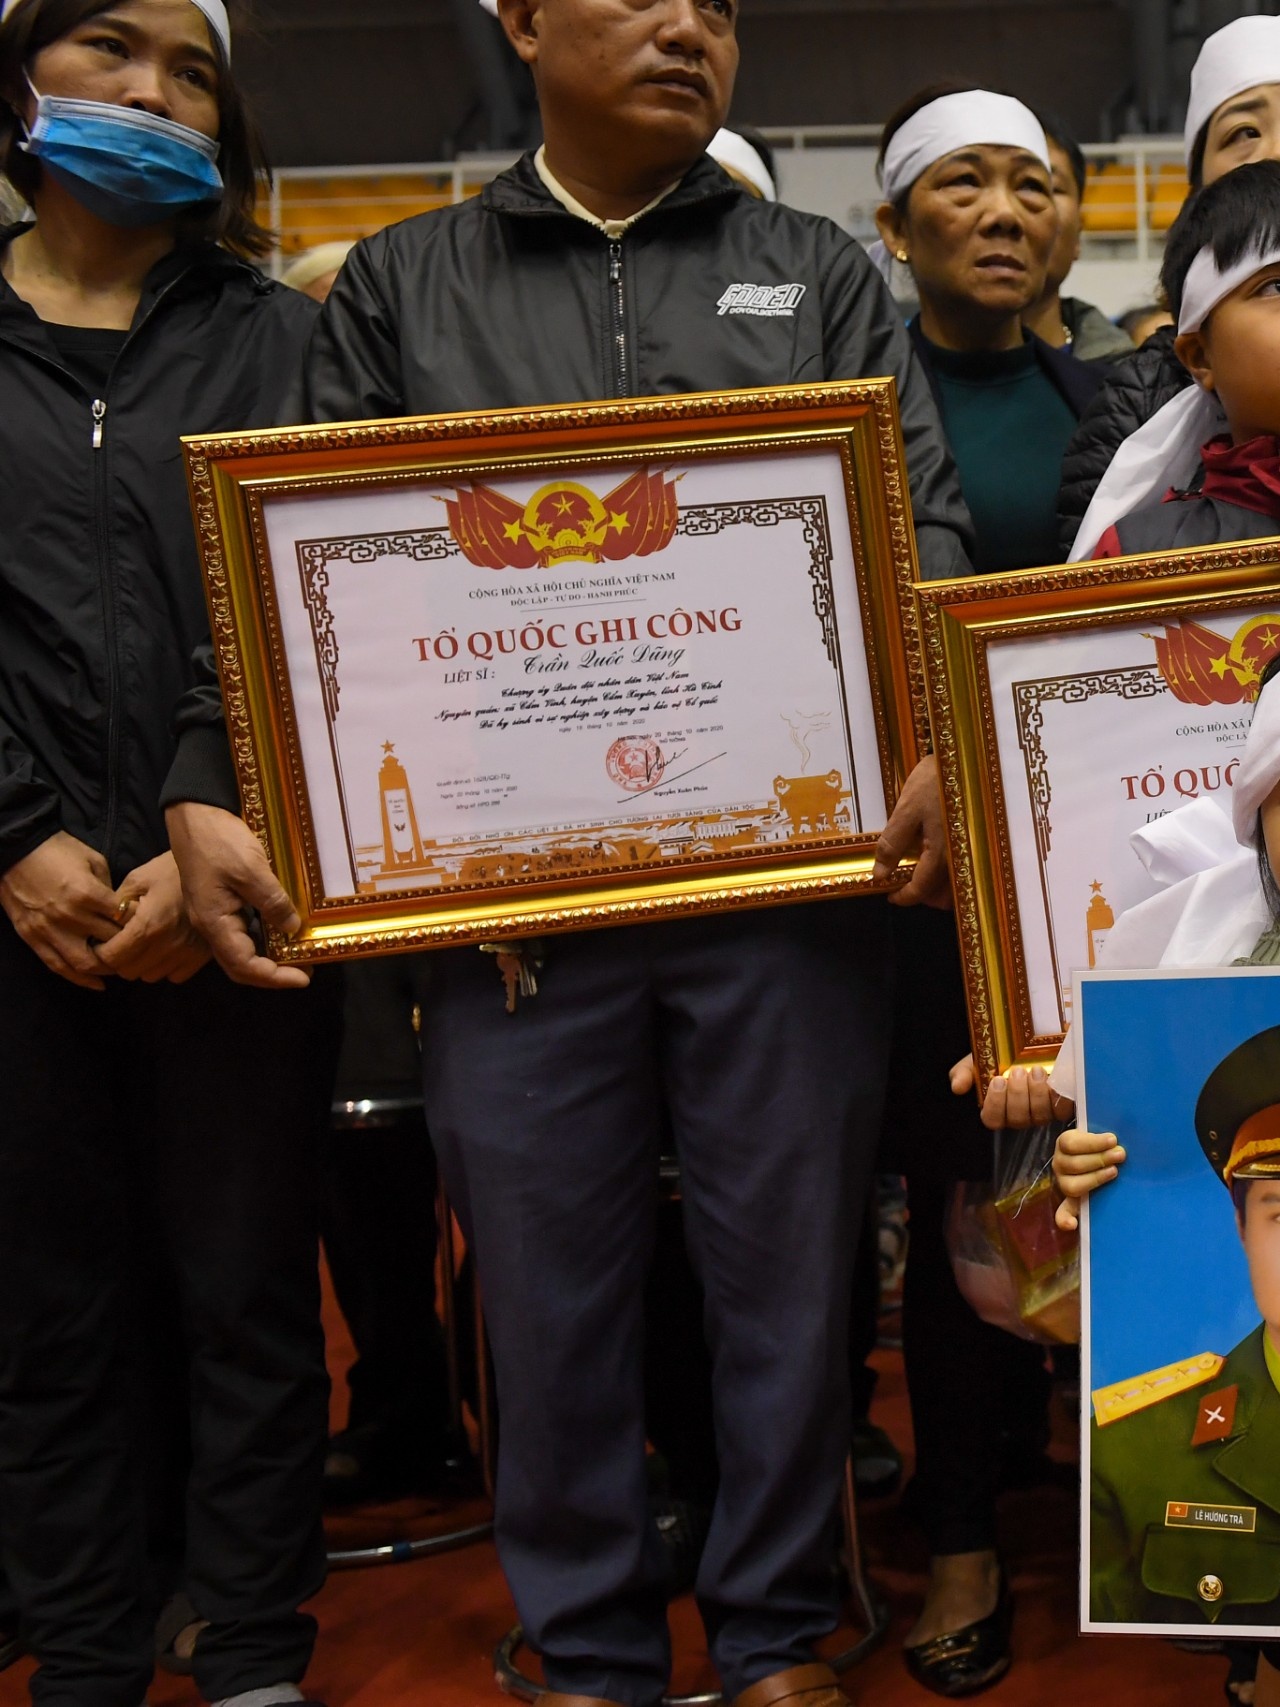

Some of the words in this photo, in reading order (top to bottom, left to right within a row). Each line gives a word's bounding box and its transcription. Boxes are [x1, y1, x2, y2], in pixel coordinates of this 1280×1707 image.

[468, 588, 499, 600] CỘNG
[501, 584, 524, 596] HÒA
[526, 582, 540, 593] XÃ
[543, 580, 563, 593] HỘI
[564, 577, 587, 590] CHỦ
[589, 576, 624, 588] NGHĨA
[625, 574, 650, 585] VIỆT
[652, 572, 676, 582] NAM
[412, 627, 459, 662] TỔ
[467, 618, 568, 661] QUỐC
[574, 616, 638, 647] GHI
[646, 607, 743, 639] CÔNG
[444, 668, 472, 684] LIỆT
[476, 667, 488, 680] SĨ
[523, 653, 569, 675] Trần
[577, 647, 624, 669] Quốc
[631, 643, 686, 667] Dũng
[1175, 725, 1204, 737] CỘNG
[1207, 720, 1228, 732] HÒA
[1231, 718, 1245, 729] XÃ
[1216, 734, 1235, 743] ĐỘC
[1236, 731, 1247, 740] LẬ
[1120, 764, 1165, 800] TỔ
[1195, 1509, 1203, 1520] LÊ
